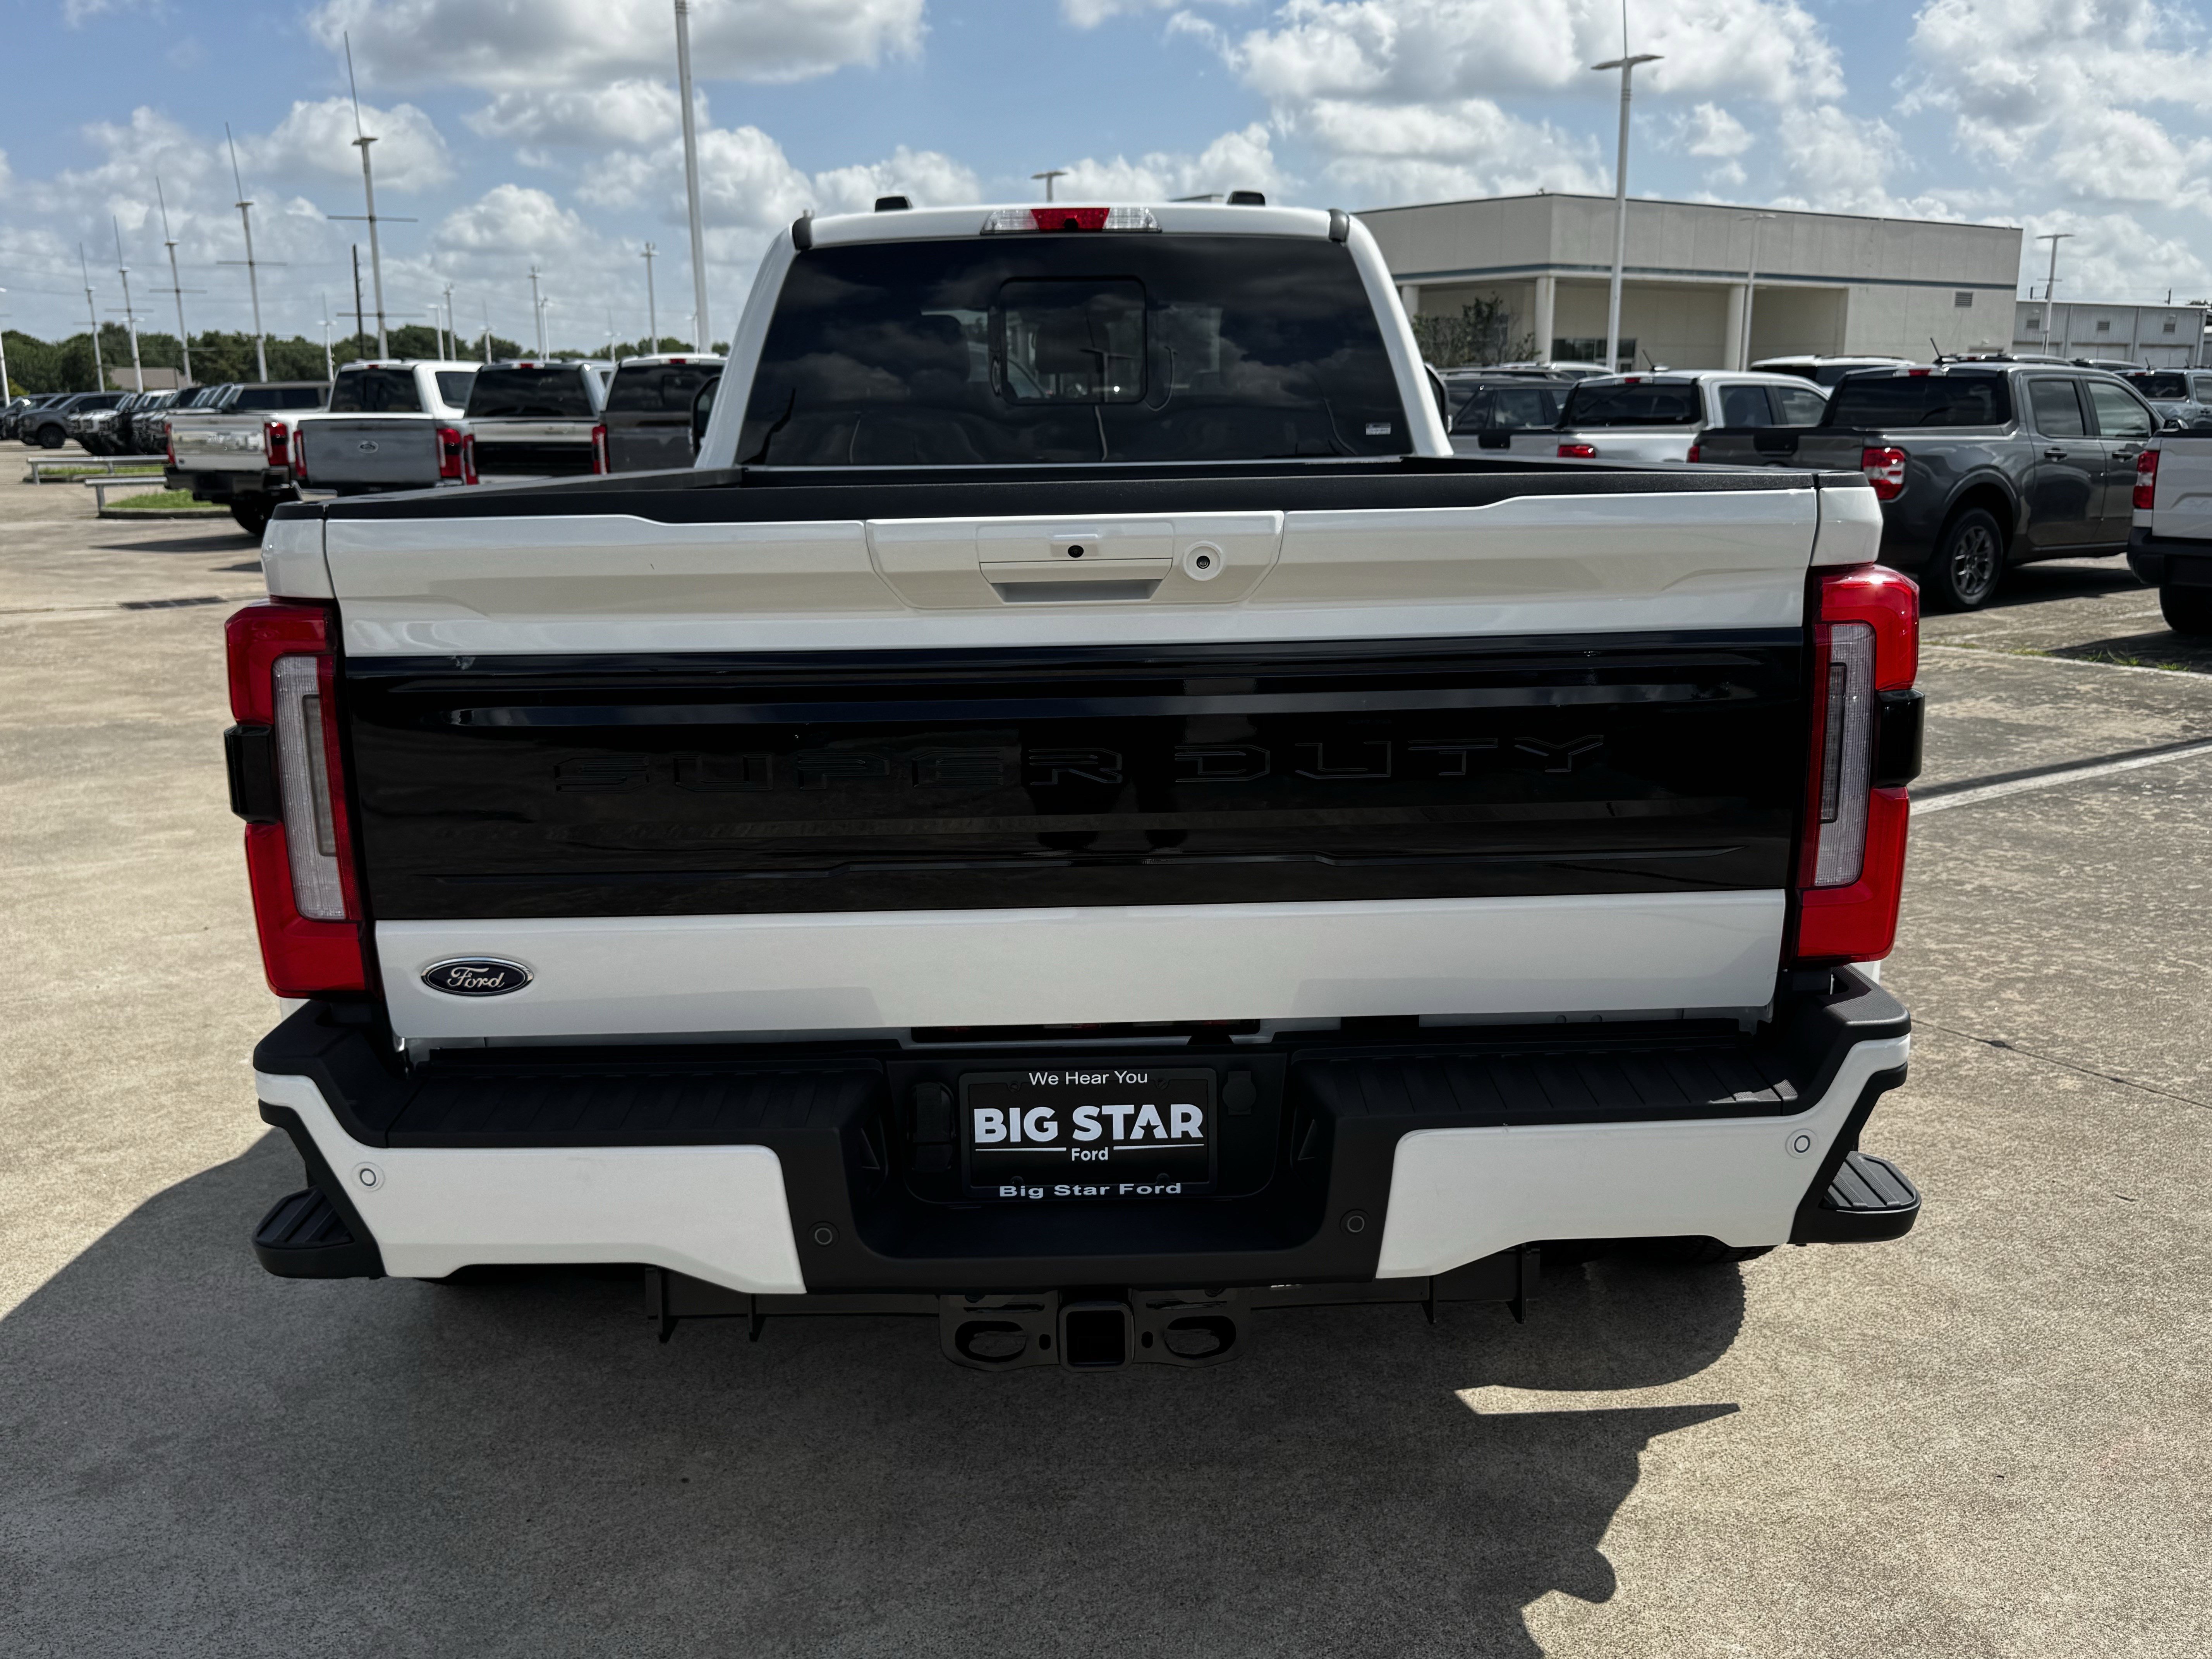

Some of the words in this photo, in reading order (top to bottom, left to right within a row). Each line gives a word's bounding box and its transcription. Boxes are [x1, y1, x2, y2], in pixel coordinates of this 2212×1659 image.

[555, 747, 1122, 793] SUPER
[1174, 733, 1604, 783] DUTY
[448, 967, 505, 988] Ford
[1029, 1072, 1059, 1085] We
[1066, 1071, 1109, 1085] Hear
[1114, 1070, 1147, 1084] You
[974, 1106, 1058, 1143] BIG
[1072, 1104, 1203, 1141] STAR
[1072, 1147, 1108, 1161] Ford
[1000, 1185, 1043, 1199] Big
[1054, 1185, 1110, 1196] Star
[1119, 1183, 1181, 1194] Ford
